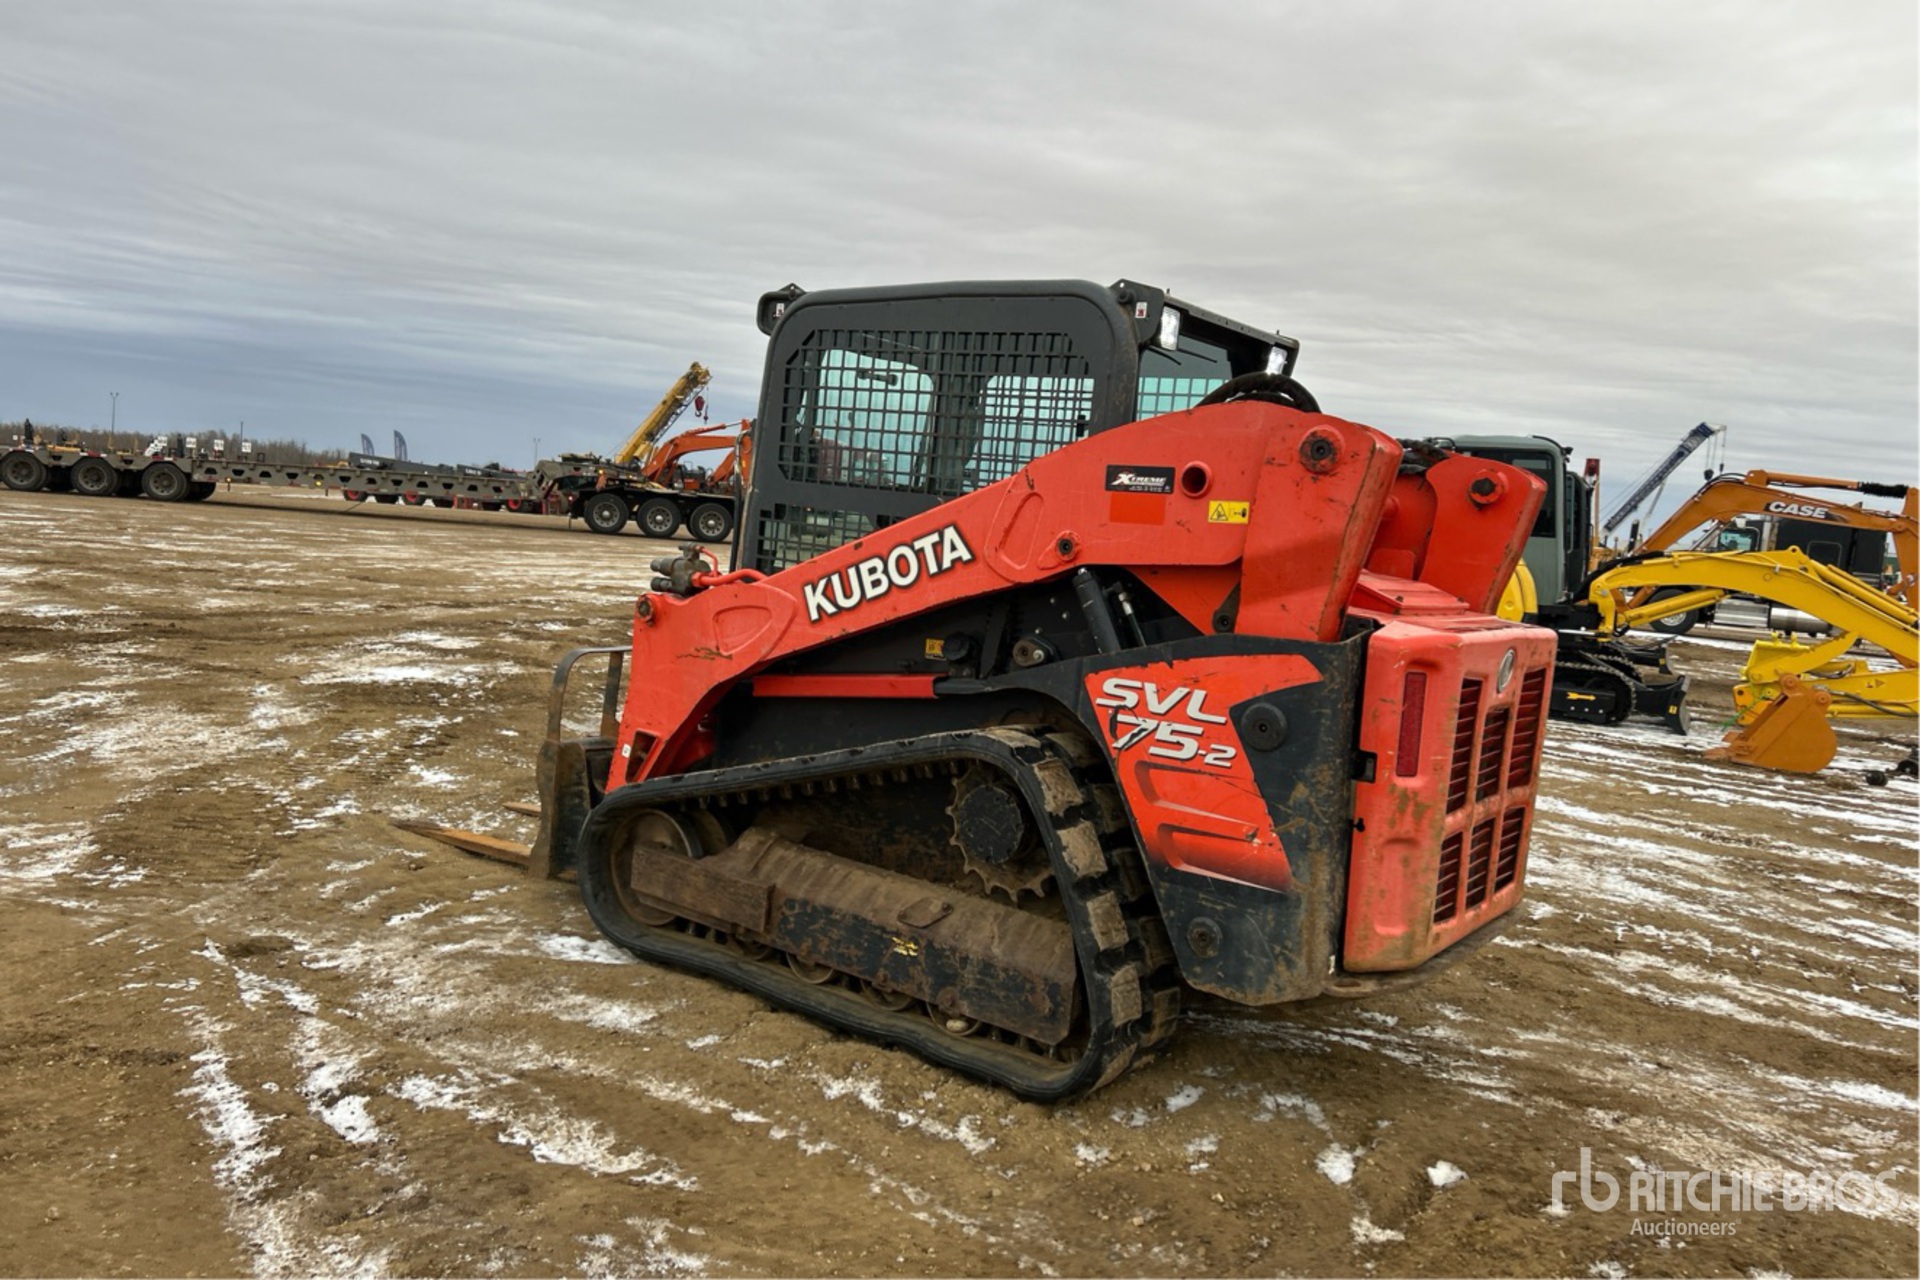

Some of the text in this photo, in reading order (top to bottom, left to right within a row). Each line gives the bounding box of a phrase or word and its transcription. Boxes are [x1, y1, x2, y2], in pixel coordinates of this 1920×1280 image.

[1769, 501, 1829, 519] CASE
[803, 524, 974, 622] KUBOTA
[1096, 677, 1228, 724] SVL
[1111, 714, 1238, 768] 75-2
